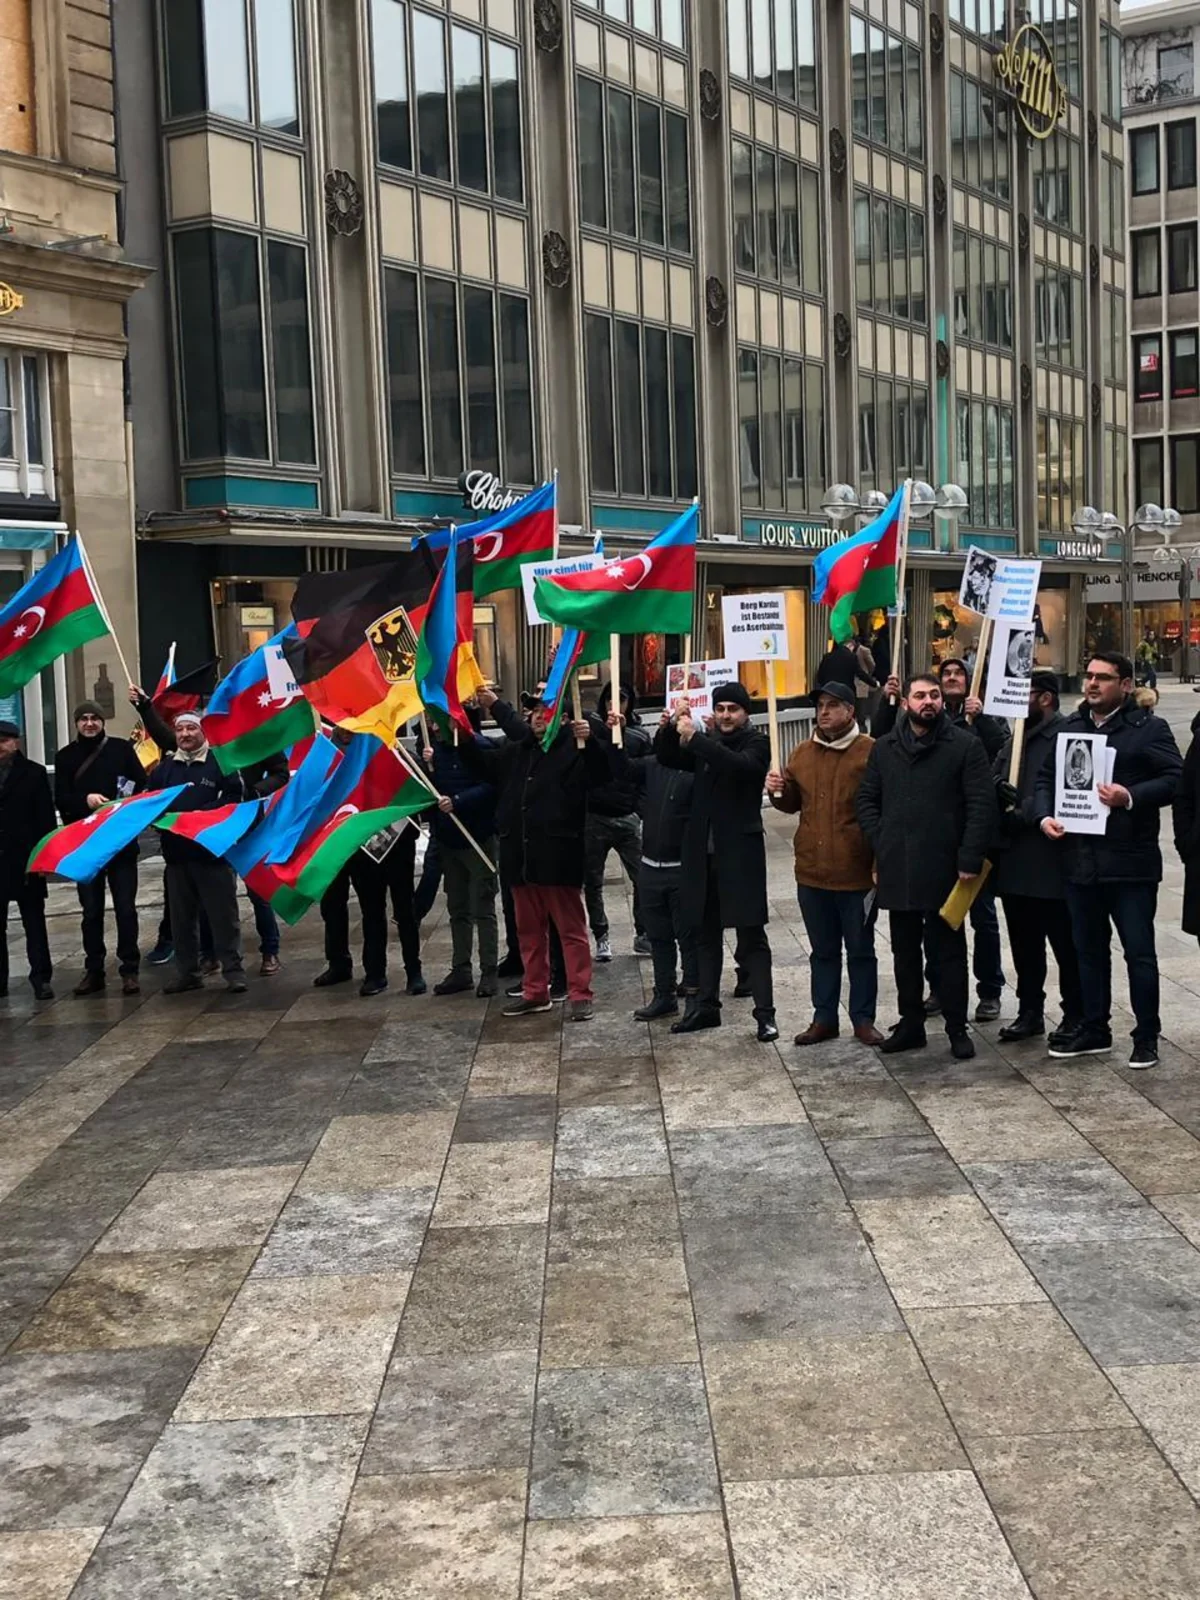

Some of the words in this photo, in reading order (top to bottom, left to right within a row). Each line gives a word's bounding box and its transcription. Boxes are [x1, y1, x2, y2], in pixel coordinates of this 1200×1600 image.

[761, 523, 796, 546] LOUIS
[1057, 541, 1102, 557] LONGCHAMP
[741, 612, 751, 621] ist
[731, 624, 746, 633] des
